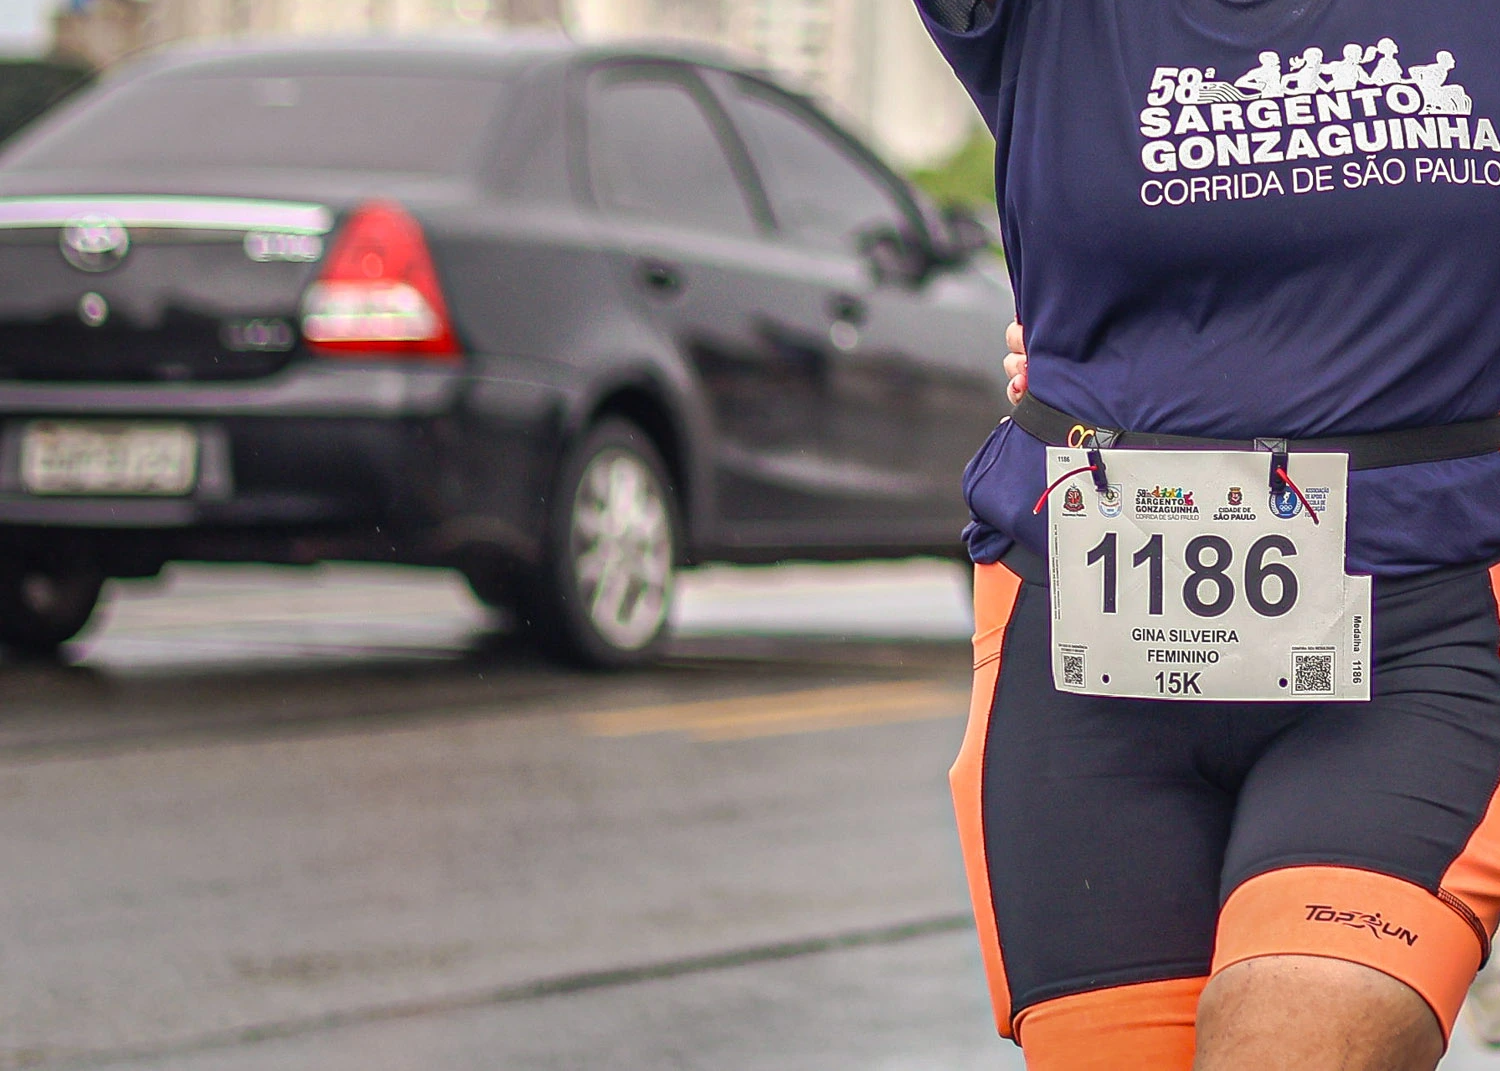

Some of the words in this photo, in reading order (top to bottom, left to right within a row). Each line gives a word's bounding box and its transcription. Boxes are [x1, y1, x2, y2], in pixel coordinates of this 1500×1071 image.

[1139, 81, 1423, 138] SARGENTO
[1140, 170, 1285, 208] CORRIDA
[1292, 164, 1335, 193] DE
[1342, 154, 1406, 187] SÃO
[1135, 497, 1184, 506] SARGENTO
[1135, 505, 1200, 514] GONZAGUINHA
[1213, 512, 1231, 521] SÃO
[1086, 531, 1299, 618] 1186
[1131, 628, 1166, 643] GINA
[1168, 629, 1240, 644] SILVEIRA
[1353, 615, 1363, 652] Medalha
[1147, 649, 1220, 665] FEMININO
[1154, 671, 1203, 695] 15K
[1352, 660, 1363, 684] 1186
